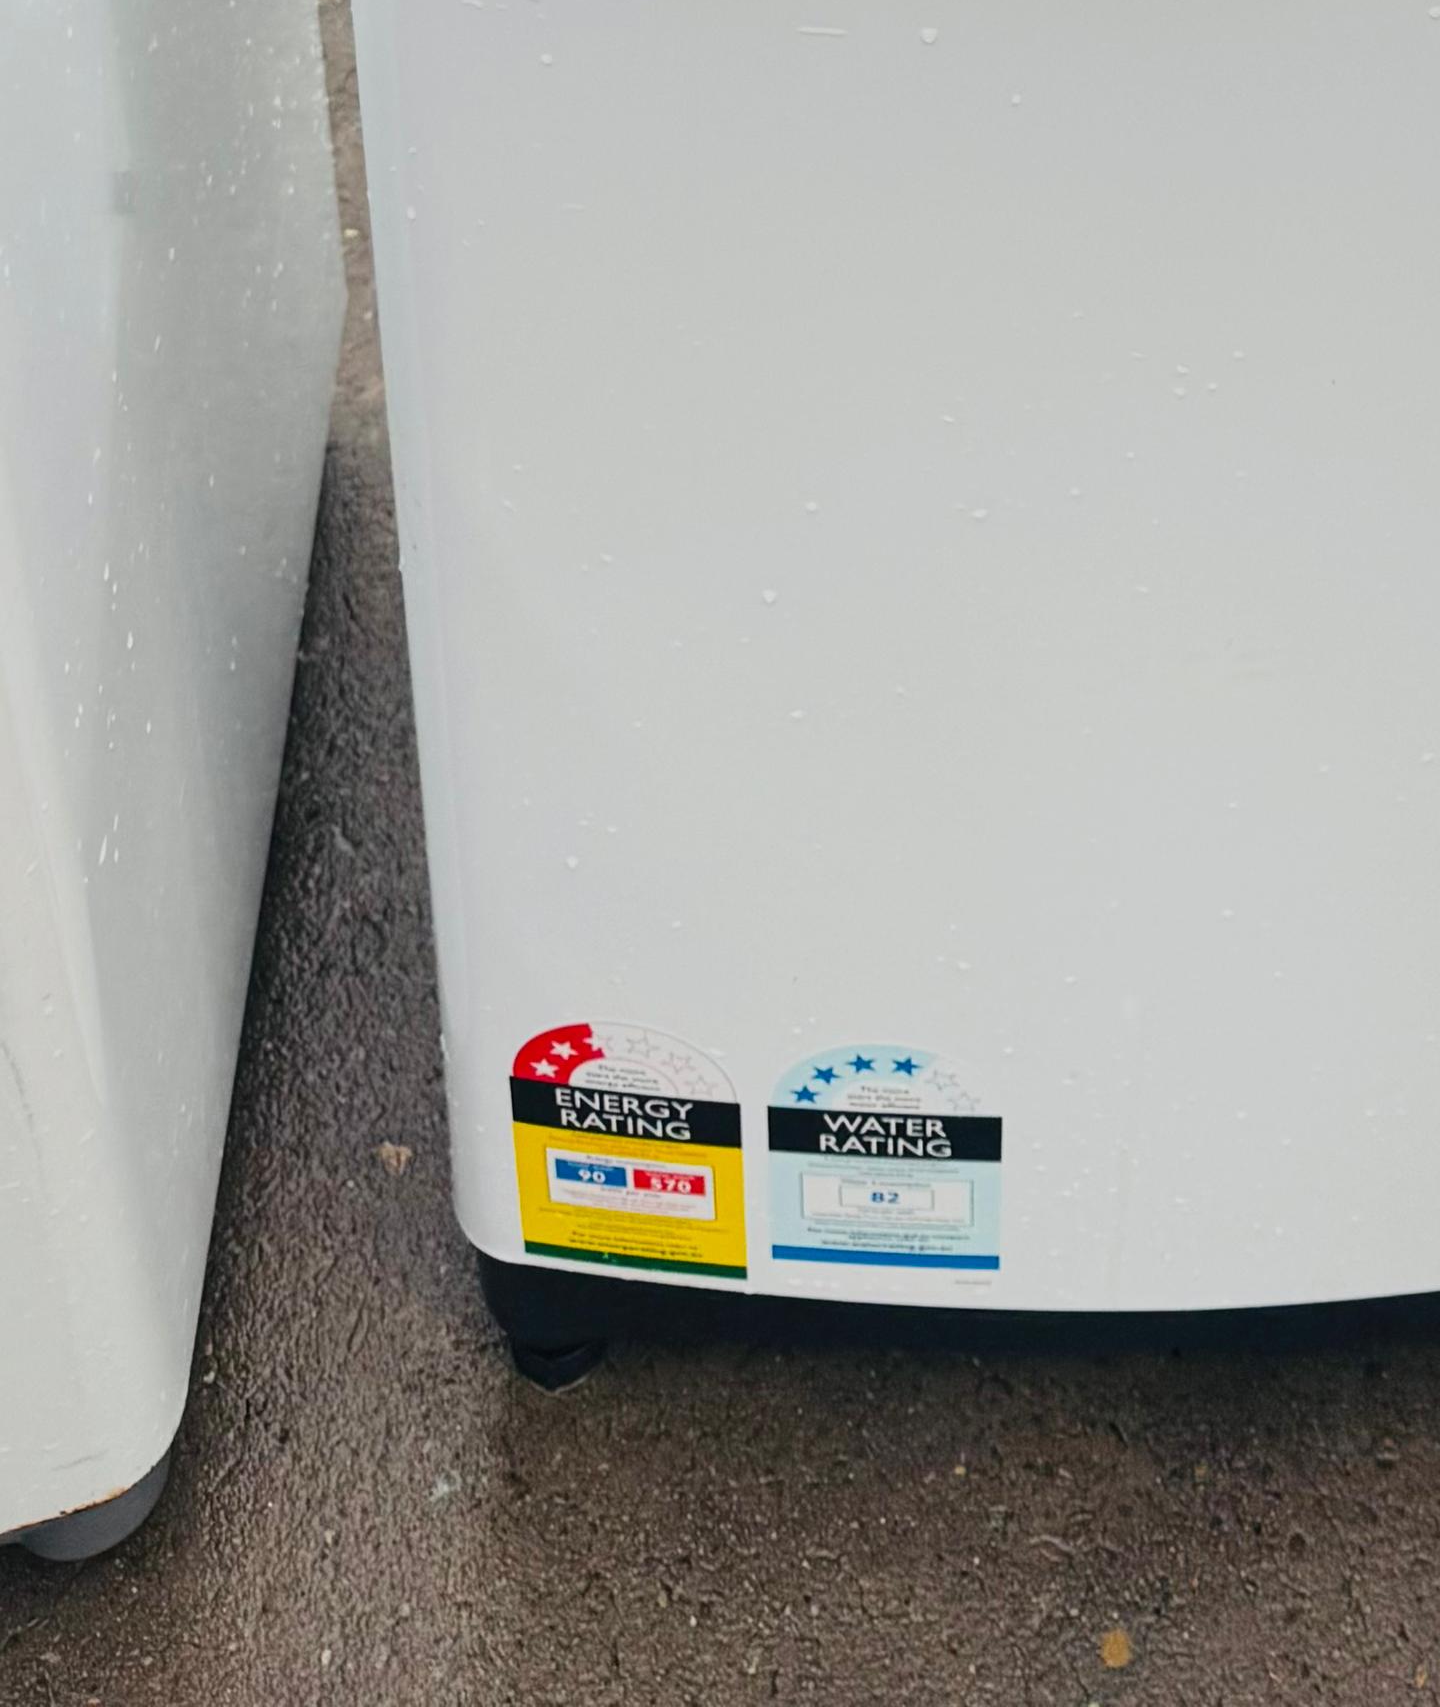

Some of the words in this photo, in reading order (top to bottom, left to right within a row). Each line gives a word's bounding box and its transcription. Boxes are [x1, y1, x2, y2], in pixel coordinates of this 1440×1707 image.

[554, 1087, 694, 1120] ENERGY
[560, 1107, 692, 1141] RATING
[823, 1112, 946, 1138] WATER
[819, 1133, 953, 1159] RATING
[578, 1168, 606, 1184] 90
[650, 1178, 692, 1194] 570
[870, 1191, 900, 1204] 82
